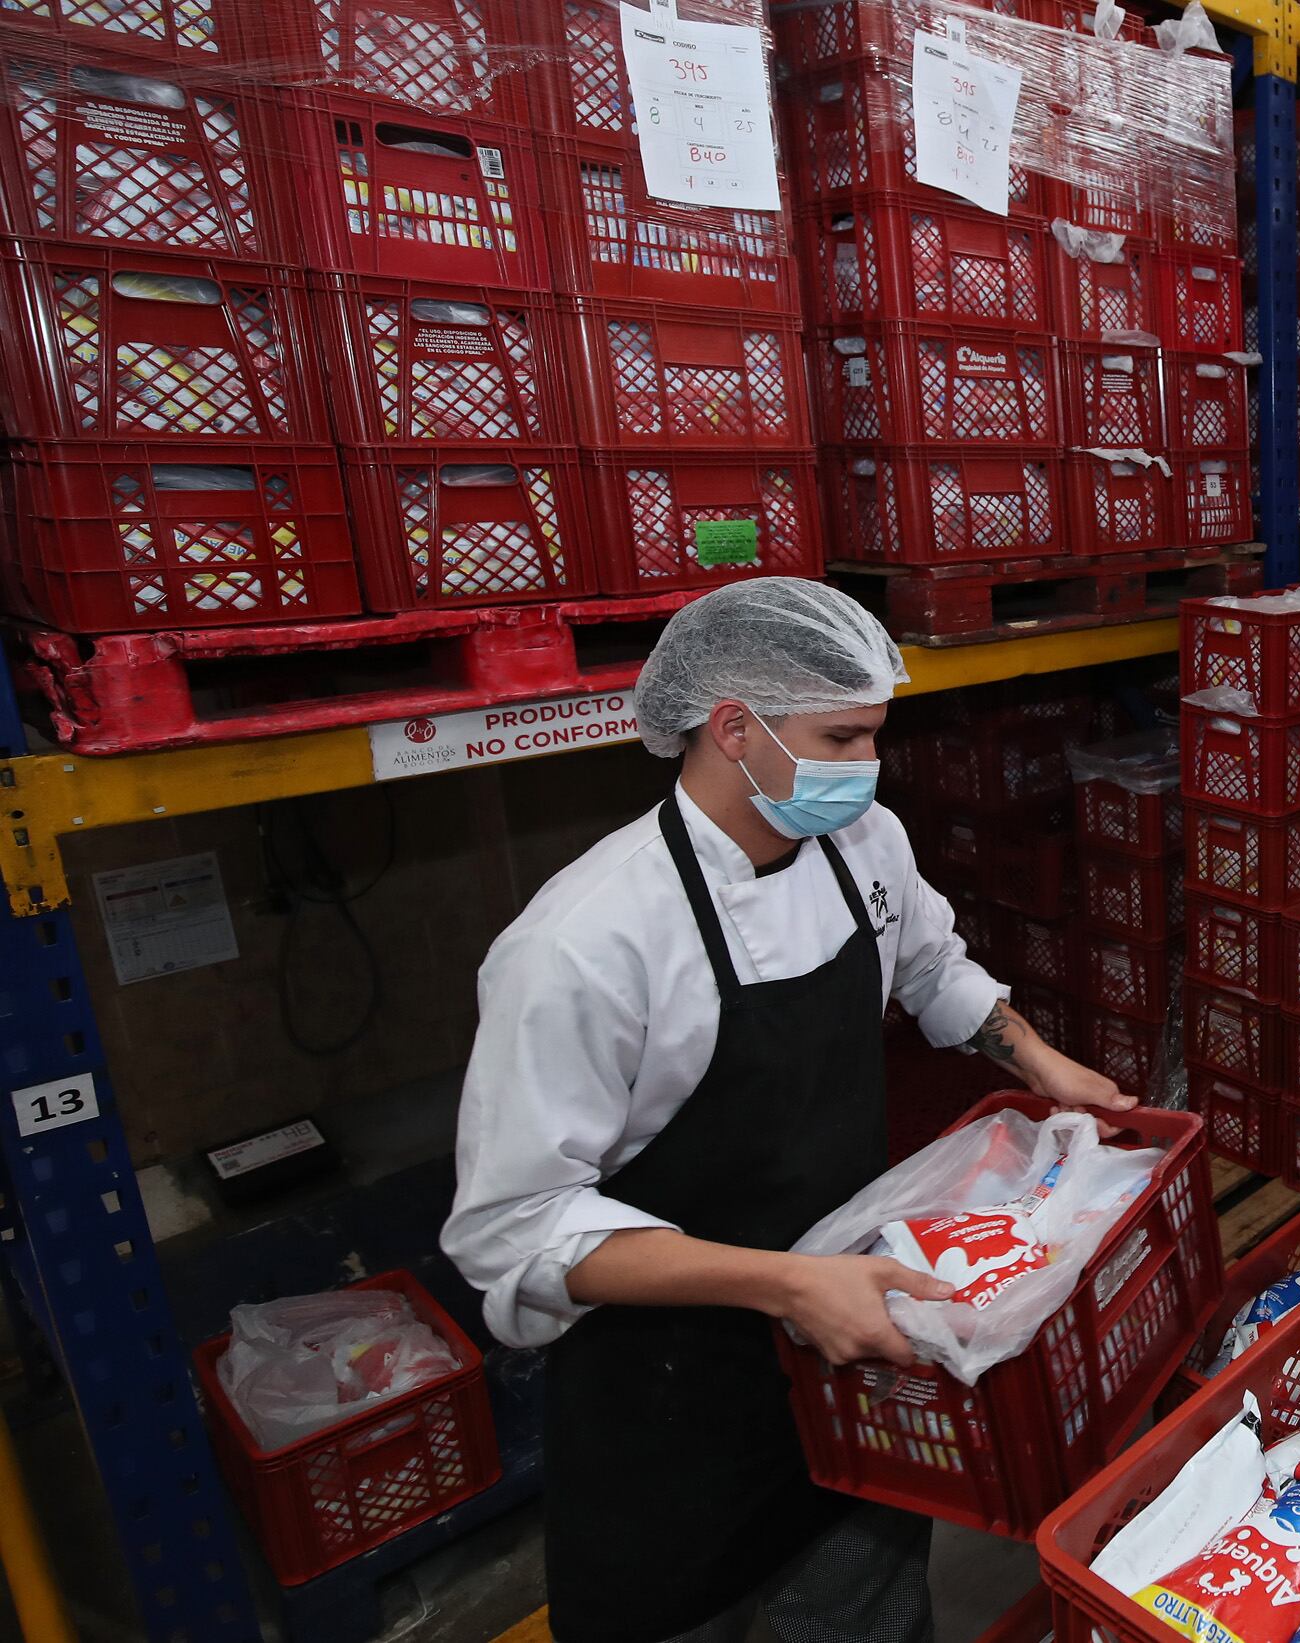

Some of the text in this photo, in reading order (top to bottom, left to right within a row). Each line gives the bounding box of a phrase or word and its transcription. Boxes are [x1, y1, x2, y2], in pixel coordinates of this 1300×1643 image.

[669, 58, 709, 81] 395
[951, 76, 976, 96] 395
[649, 106, 661, 125] 8
[693, 116, 704, 132] 4
[733, 119, 756, 133] 25
[484, 696, 625, 731] PRODUCTO
[466, 717, 639, 759] NO CONFORM
[393, 748, 456, 765] ALIMENTOS
[31, 1089, 84, 1122] 13
